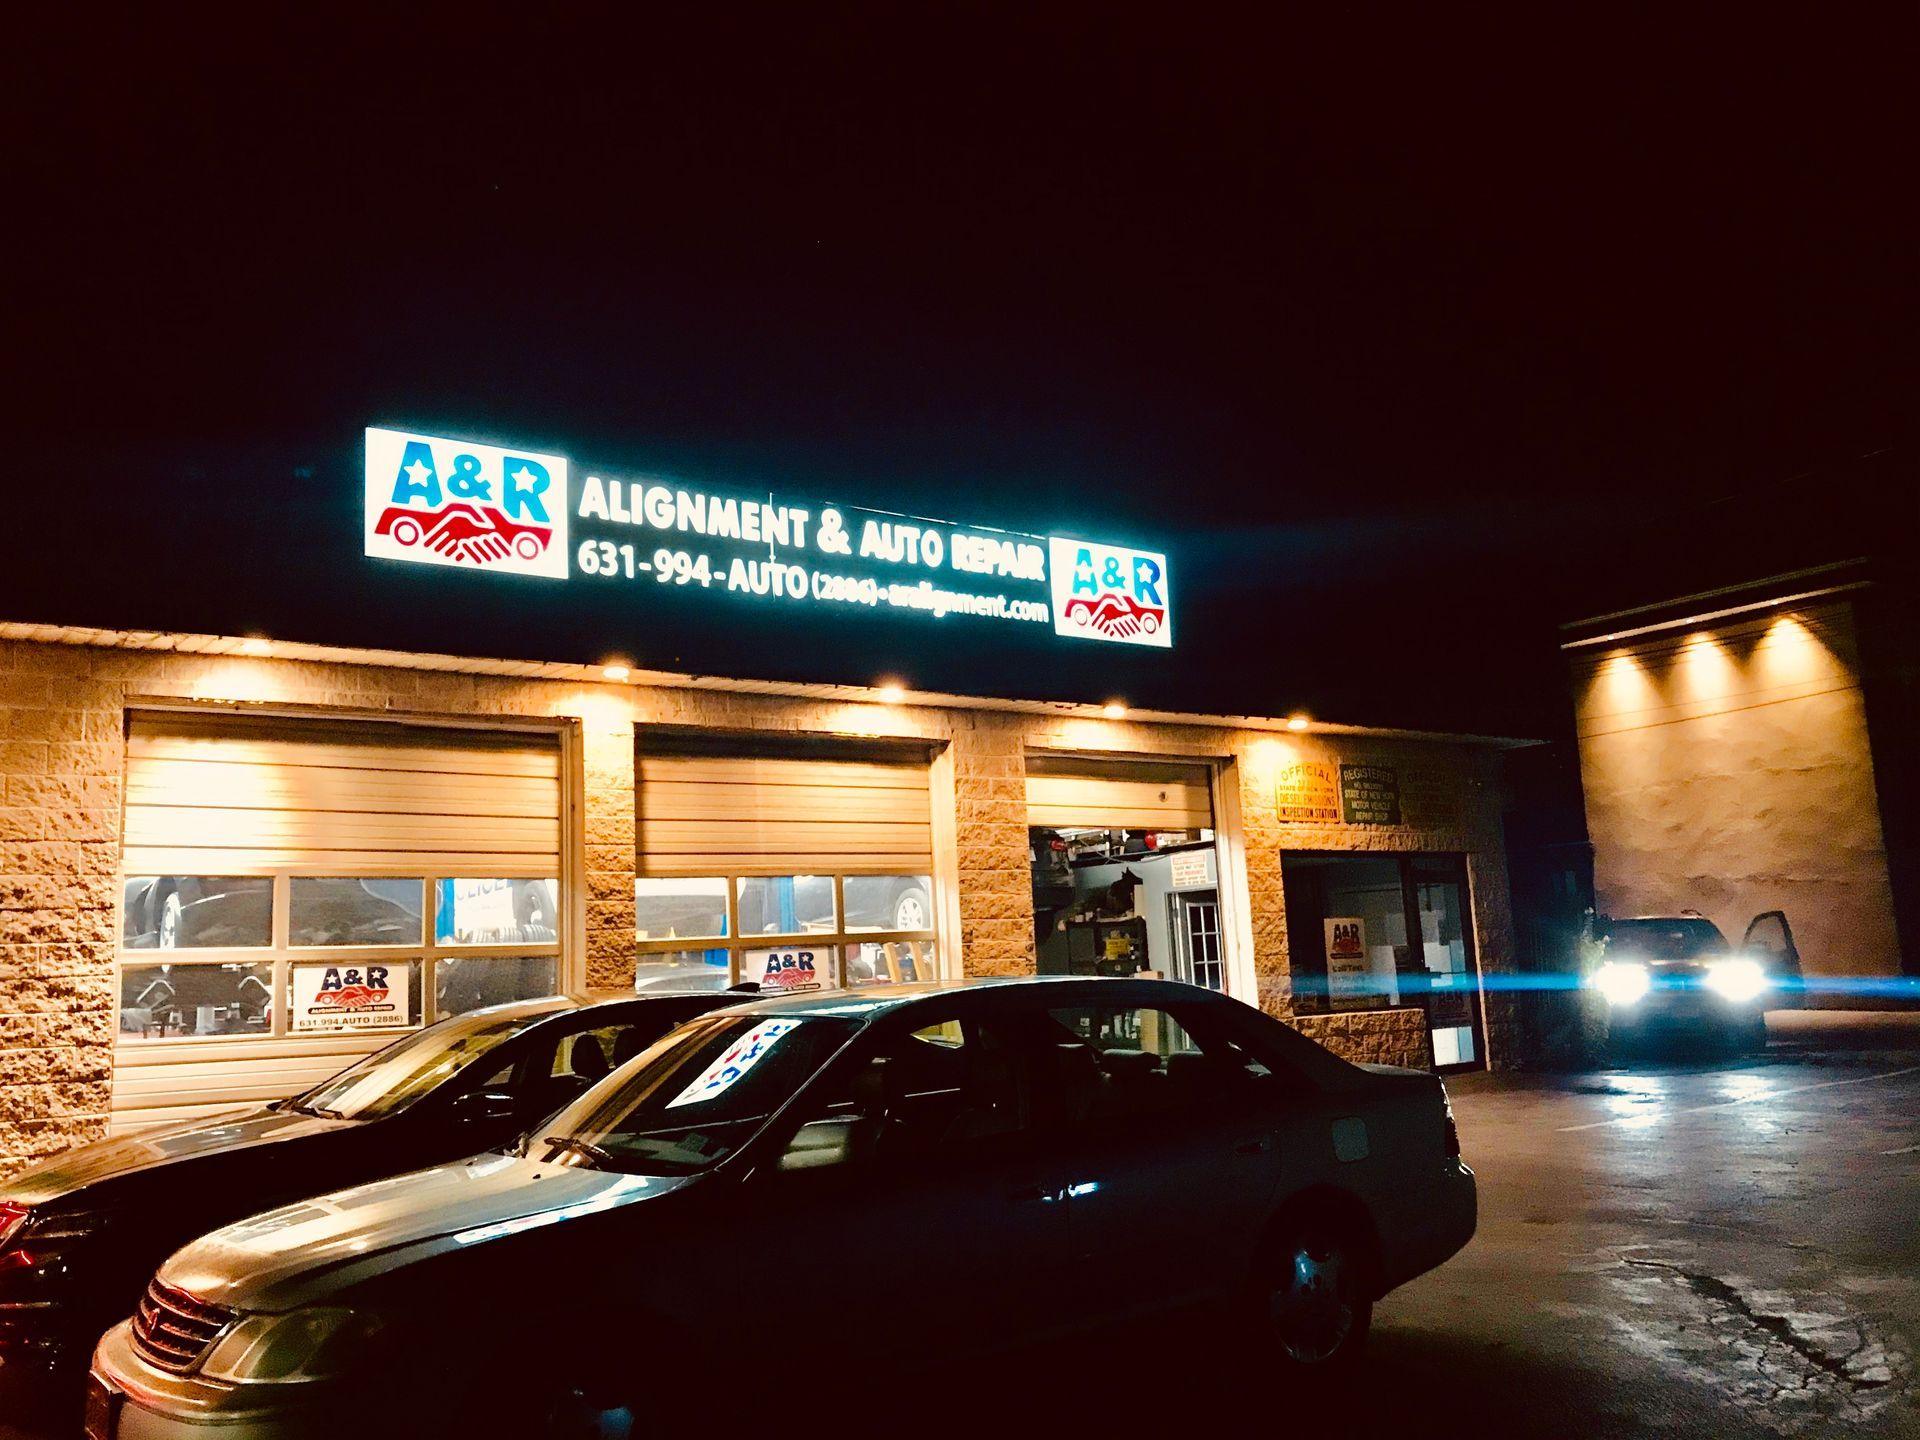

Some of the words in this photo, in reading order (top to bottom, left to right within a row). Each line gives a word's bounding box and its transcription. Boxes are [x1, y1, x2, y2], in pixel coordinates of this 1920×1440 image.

[391, 441, 550, 523] A&R
[578, 477, 809, 547] ALIGNMENT
[816, 508, 852, 555] &
[860, 520, 943, 568] AUTO
[951, 534, 1046, 582] REPAIR
[1072, 548, 1161, 606] A&R
[1281, 765, 1332, 784] OFFICIAL
[1343, 768, 1393, 783] REGISTERED
[1345, 789, 1360, 799] STATE
[1361, 790, 1368, 800] OF
[1280, 806, 1314, 818] INSPECTION
[1315, 808, 1338, 819] STATION
[1351, 800, 1370, 810] MOTOR
[765, 952, 815, 973] A&R
[321, 966, 389, 991] A&R
